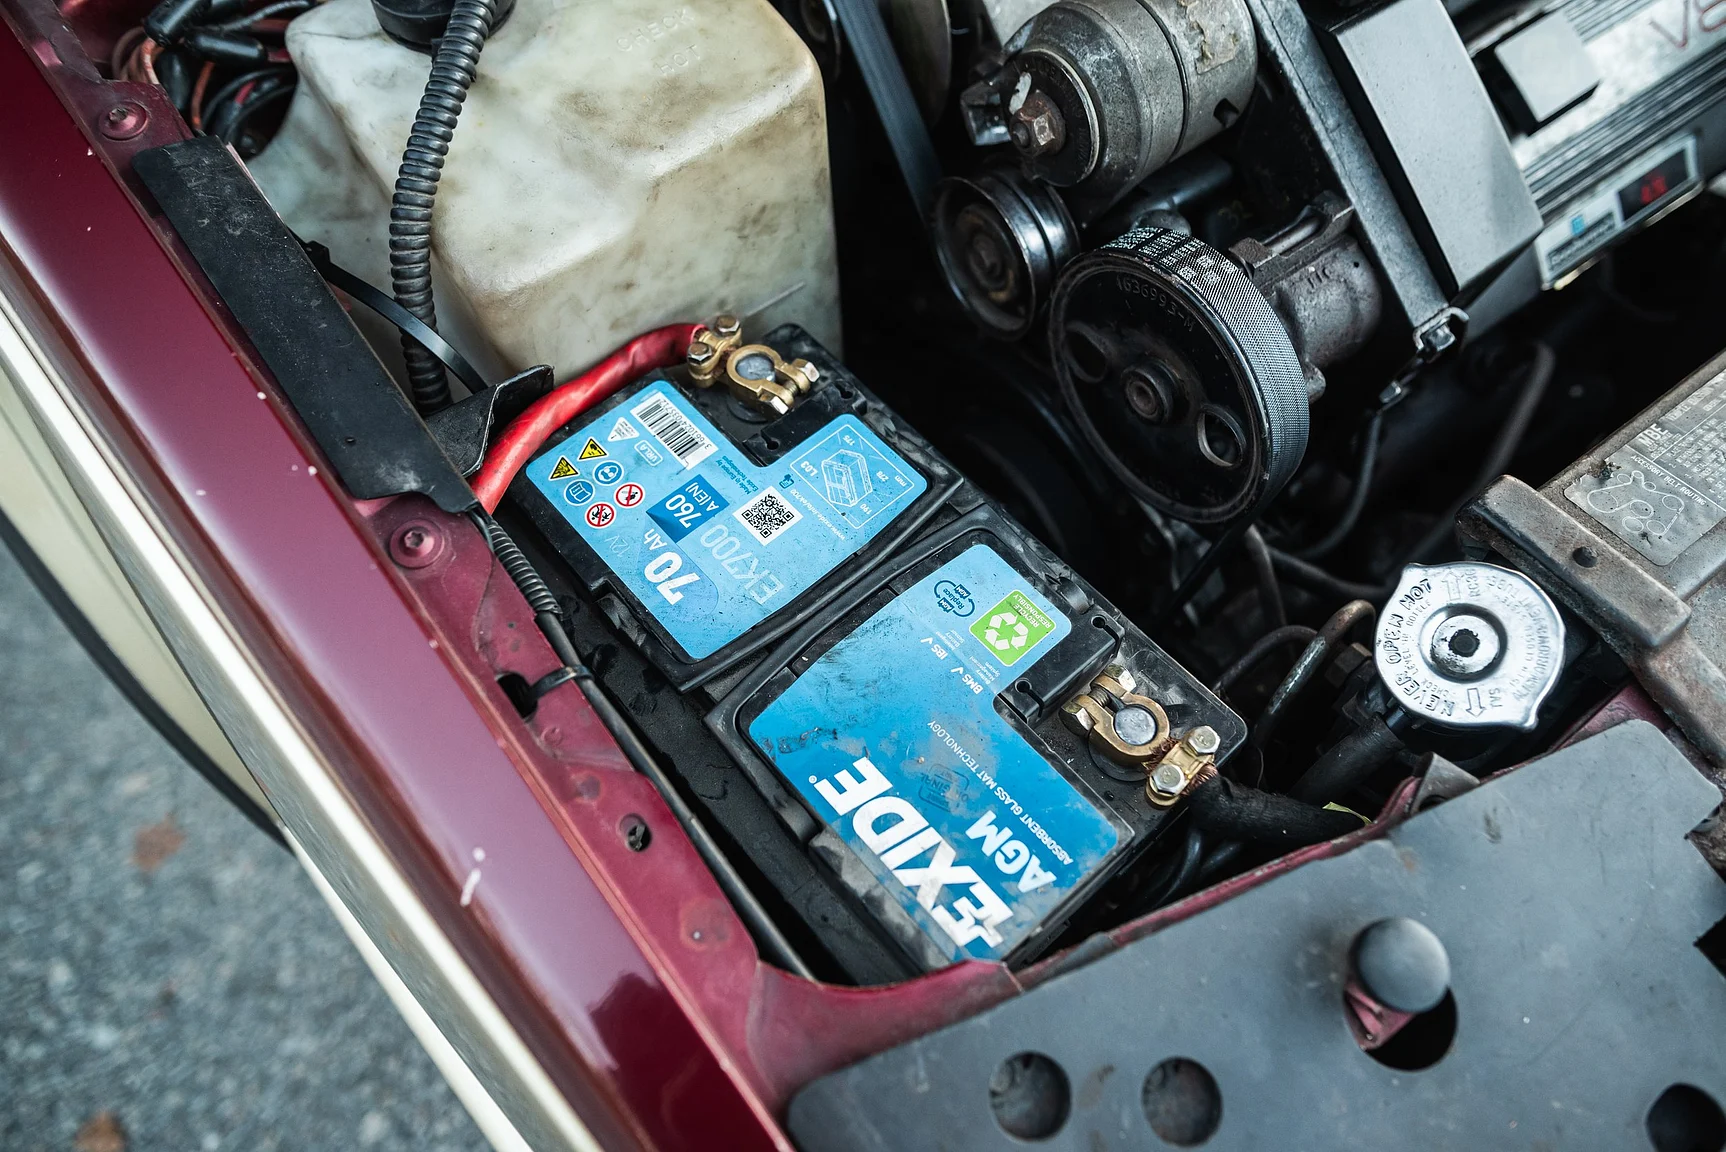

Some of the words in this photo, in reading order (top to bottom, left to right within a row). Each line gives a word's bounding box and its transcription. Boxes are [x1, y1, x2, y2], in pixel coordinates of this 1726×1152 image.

[617, 9, 694, 52] CHECK
[652, 44, 700, 76] HOT
[680, 420, 706, 442] 661024
[843, 435, 856, 446] 175
[639, 444, 657, 462] VRLA
[721, 464, 736, 480] Europe
[722, 456, 747, 481] Technologies
[876, 471, 889, 482] 278
[739, 482, 751, 494] Made
[746, 480, 758, 492] Exide
[895, 476, 908, 486] mm
[1630, 456, 1664, 476] ACCESSORY
[1664, 476, 1681, 488] BELT
[1680, 486, 1706, 506] ROUTING
[665, 493, 703, 528] 760
[790, 489, 846, 540] www.exide.info/ek700
[860, 504, 872, 515] 190
[605, 534, 630, 558] 12V
[644, 528, 668, 550] Ah
[701, 524, 784, 605] EK700
[644, 551, 700, 606] 70
[1486, 575, 1518, 598] TUBES
[943, 588, 964, 610] Replace
[956, 586, 969, 597] AGM
[1400, 578, 1432, 610] HOT
[939, 600, 953, 611] AGM
[1013, 594, 1052, 628] RESPONSIBLY
[1014, 604, 1040, 628] RECYCLE
[1406, 599, 1431, 626] BOTTLE
[1519, 596, 1545, 624] VENT
[946, 632, 960, 648] Battery
[950, 630, 964, 644] Sensor
[1383, 613, 1404, 664] OPEN
[931, 644, 948, 660] IBS
[1402, 650, 1419, 676] LEVEL
[1536, 634, 1551, 674] ARROW
[970, 656, 996, 681] Management
[976, 670, 992, 685] Battery
[984, 662, 1000, 678] System
[962, 674, 983, 694] BMS
[1395, 673, 1455, 716] NEVER
[1420, 678, 1450, 698] CHECK
[1512, 674, 1542, 701] ALIGN
[927, 720, 982, 772] TECHNOLOGY
[974, 769, 996, 790] MAT
[994, 786, 1022, 815] GLASS
[814, 756, 1014, 948] EXIDE
[965, 810, 1057, 893] AGM
[1019, 816, 1073, 866] ABSORBENT
